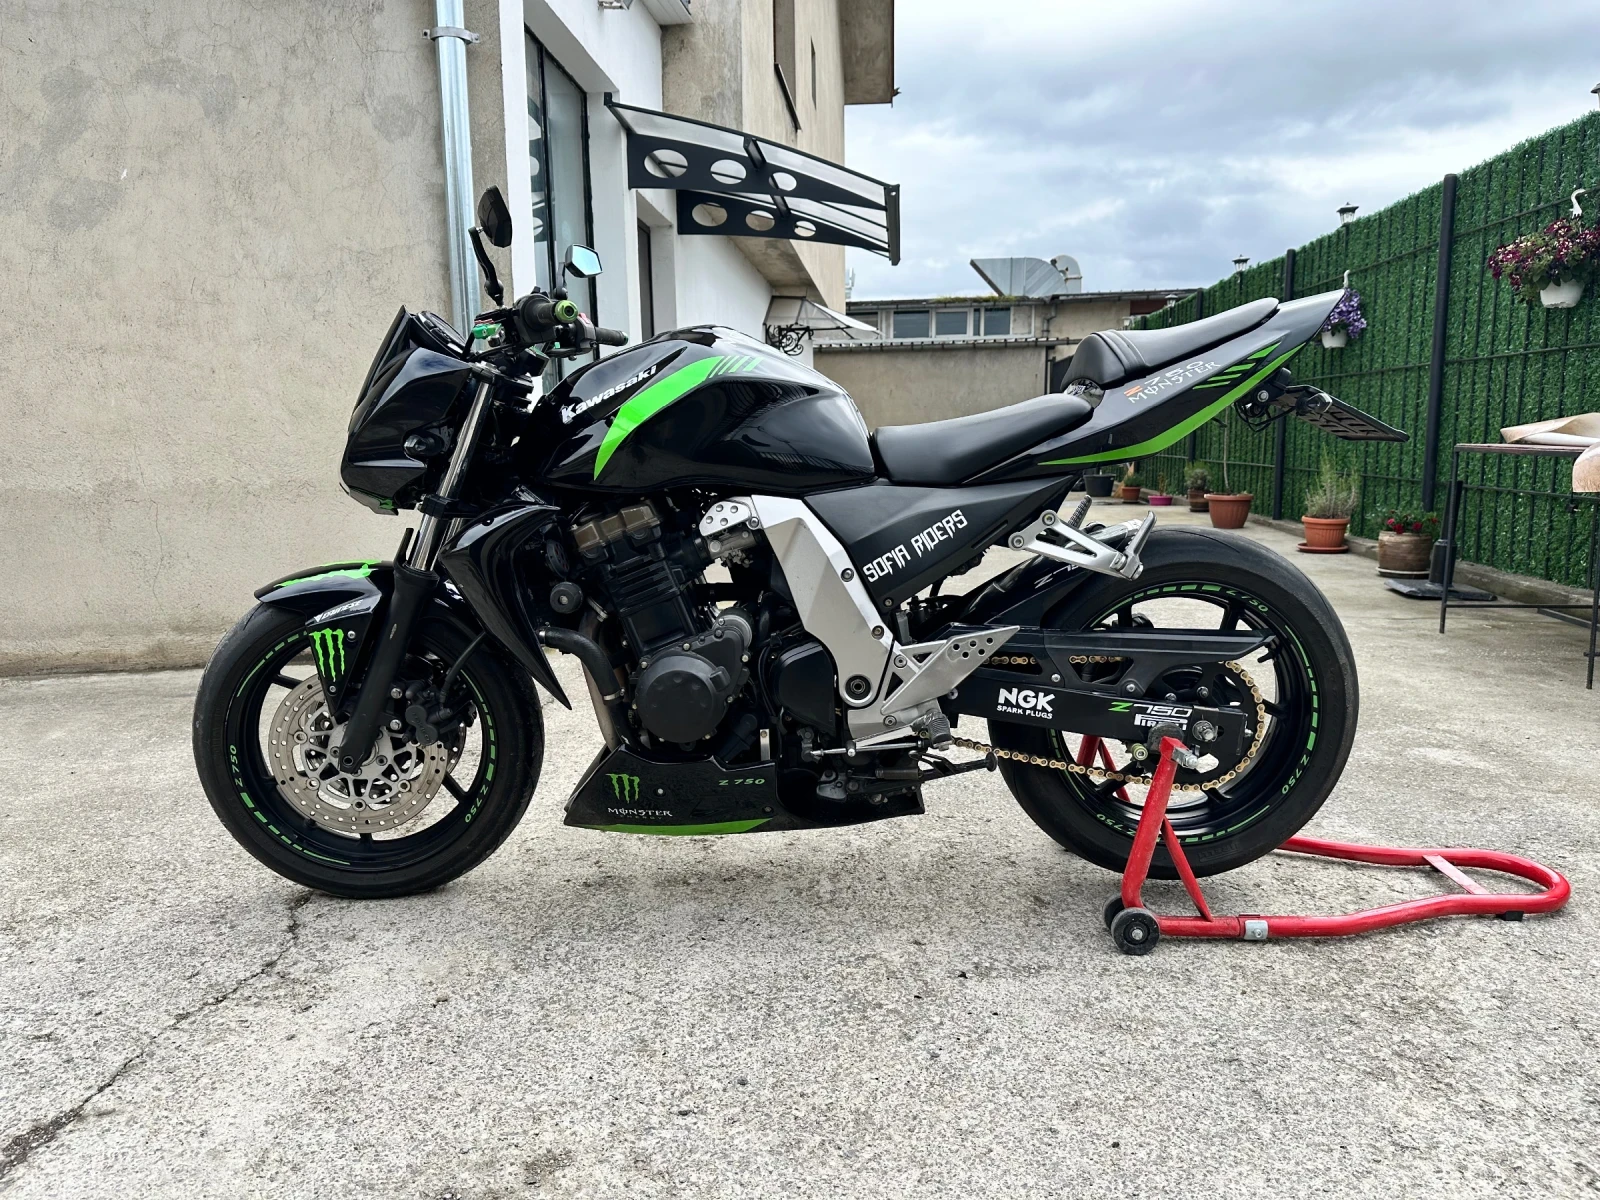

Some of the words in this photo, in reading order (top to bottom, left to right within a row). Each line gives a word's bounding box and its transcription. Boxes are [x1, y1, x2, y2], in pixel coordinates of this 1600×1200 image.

[560, 365, 657, 424] Kawasaki
[862, 544, 911, 583] SOFIA
[910, 509, 968, 558] RIDERS
[998, 687, 1056, 713] NGK
[996, 704, 1024, 715] SPARK
[1025, 709, 1054, 720] PLUGS
[1129, 713, 1188, 731] PIRI
[607, 807, 674, 818] MONSTER
